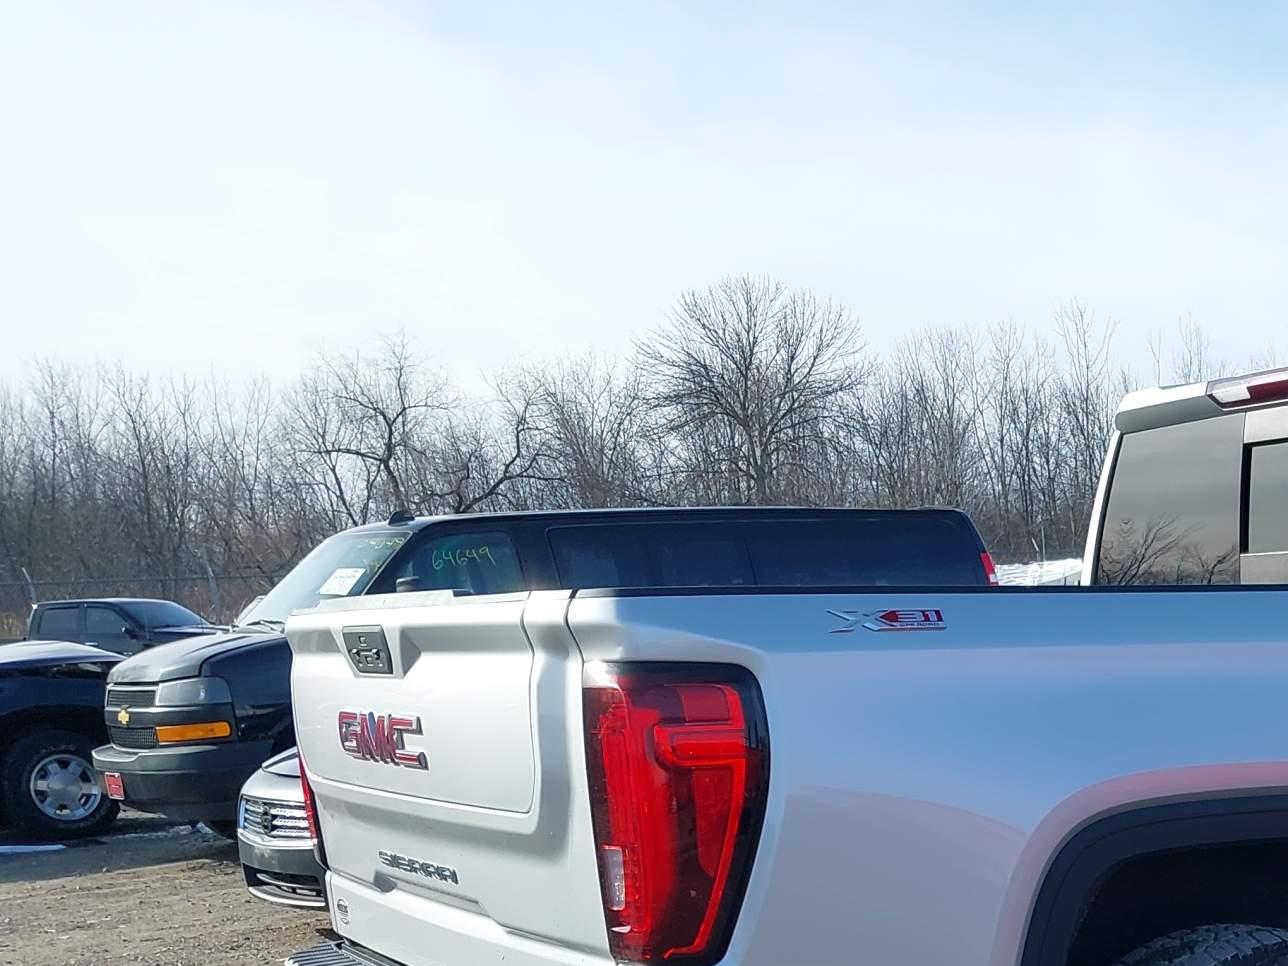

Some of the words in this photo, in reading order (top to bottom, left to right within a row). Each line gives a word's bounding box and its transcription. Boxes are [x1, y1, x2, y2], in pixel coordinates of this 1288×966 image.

[432, 546, 496, 570] 64649
[338, 711, 429, 771] GMC
[378, 850, 459, 885] SIERRA
